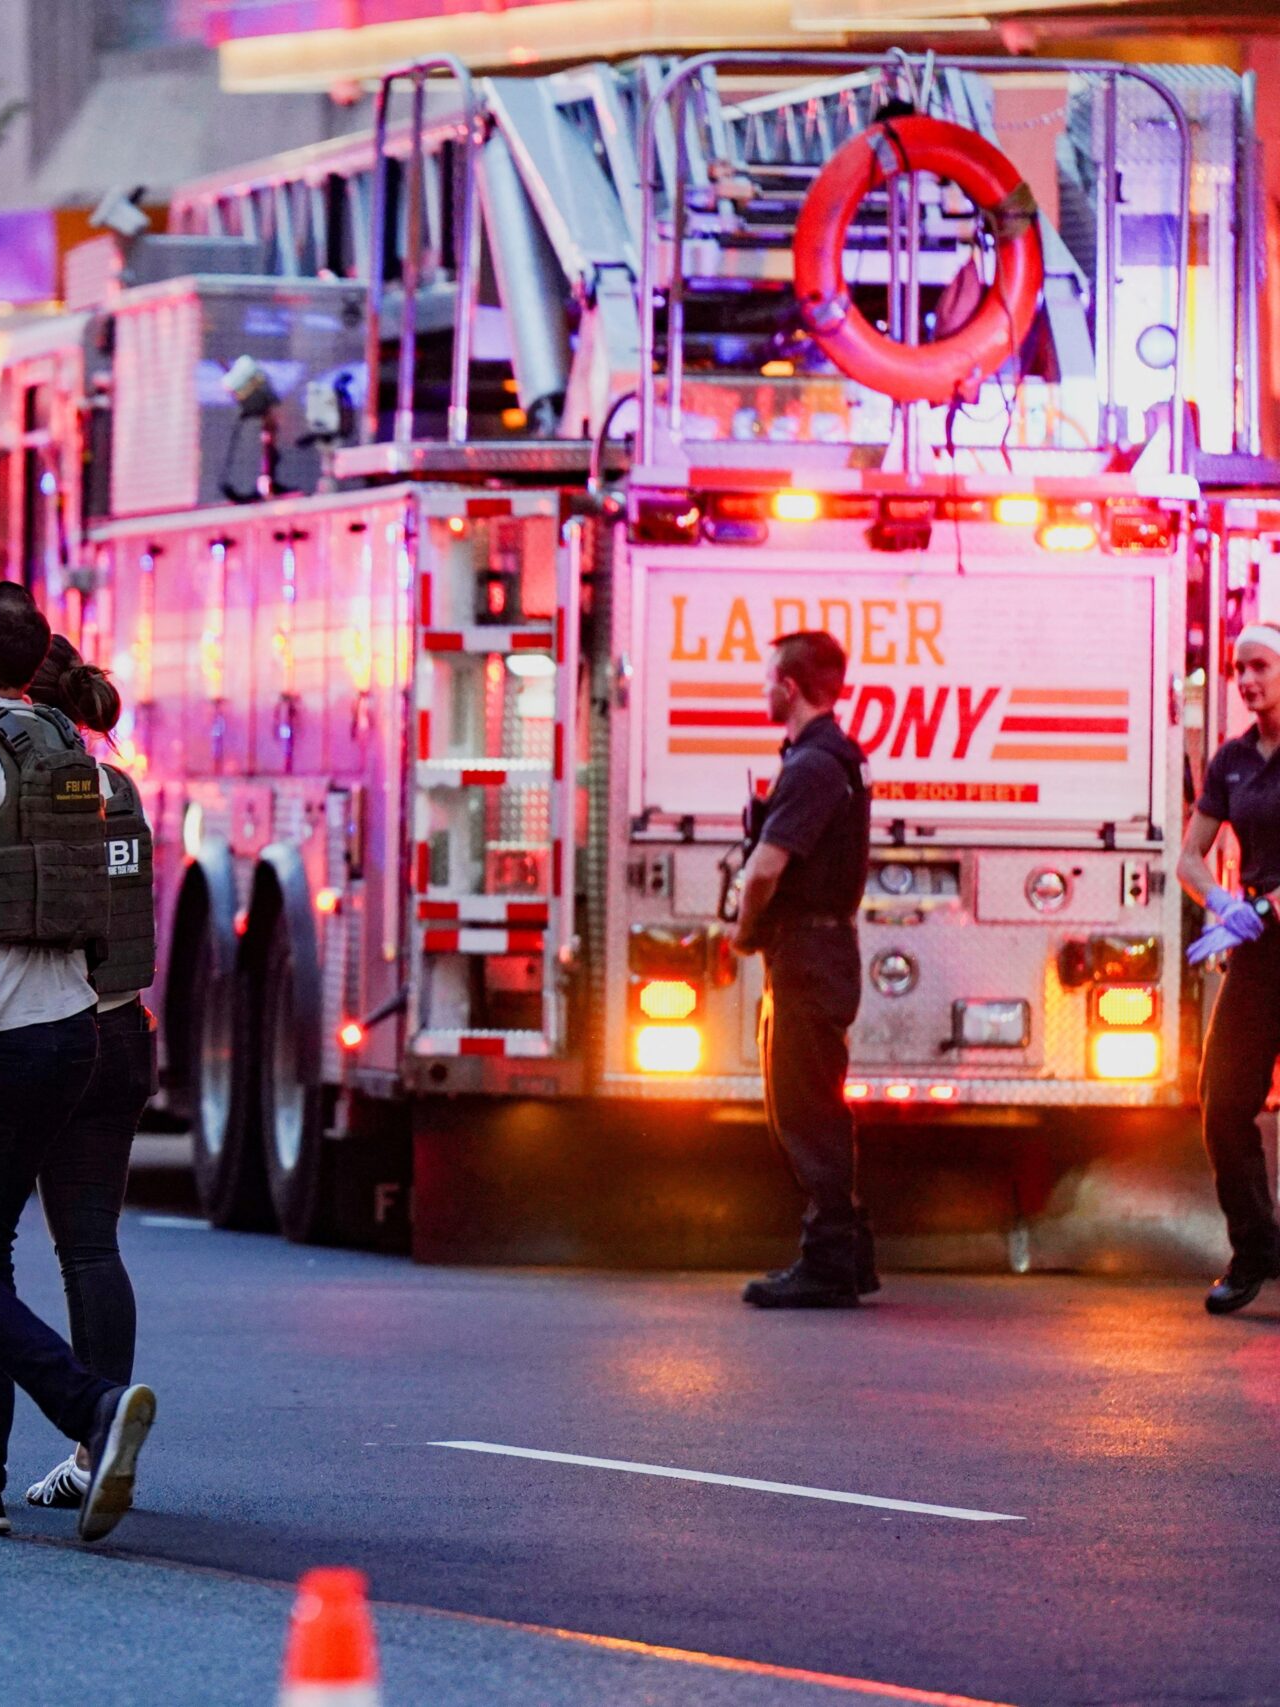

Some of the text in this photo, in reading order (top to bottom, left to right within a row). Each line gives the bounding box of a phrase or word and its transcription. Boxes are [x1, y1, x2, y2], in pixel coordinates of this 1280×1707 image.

[670, 596, 945, 666] LADDER
[65, 780, 91, 792] FBI NY
[915, 783, 959, 801] 200
[966, 784, 1027, 802] FEET
[104, 838, 139, 866] BI
